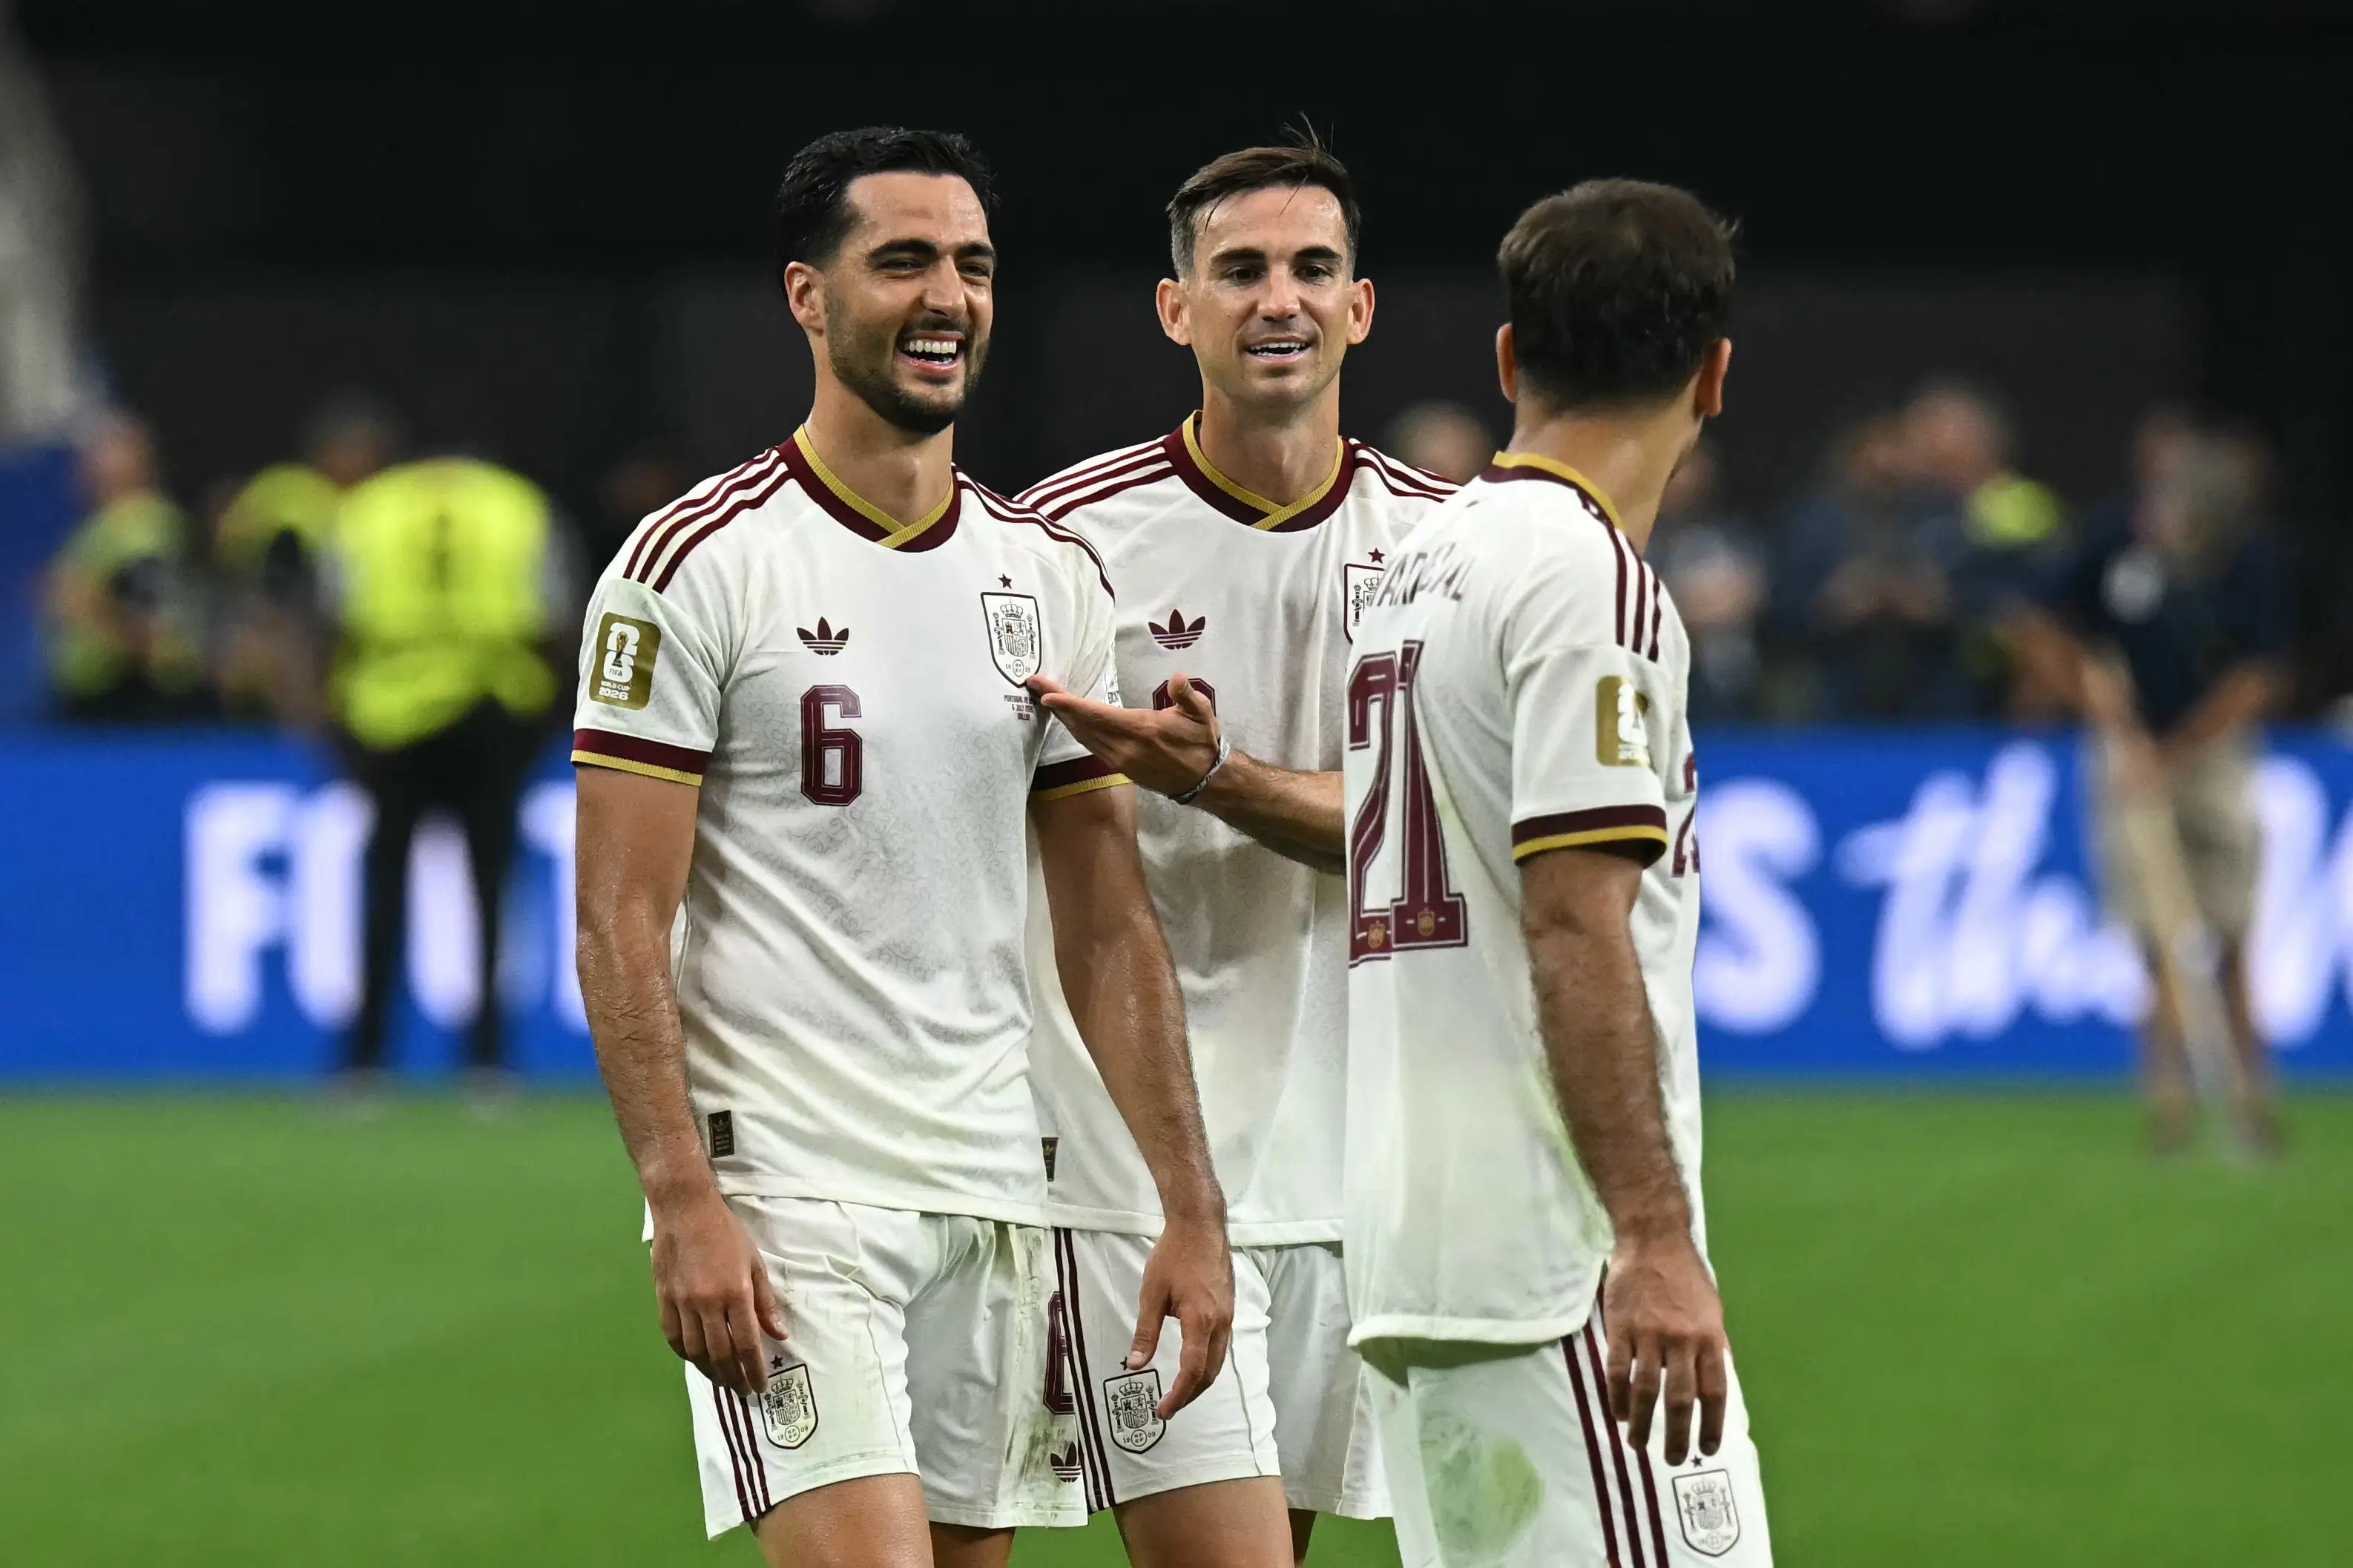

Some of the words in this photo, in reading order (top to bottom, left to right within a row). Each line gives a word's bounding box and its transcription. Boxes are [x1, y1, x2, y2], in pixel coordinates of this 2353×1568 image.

[599, 686, 629, 701] 2026
[609, 668, 623, 676] FIFA
[800, 684, 863, 806] 6
[1349, 639, 1469, 969] 21
